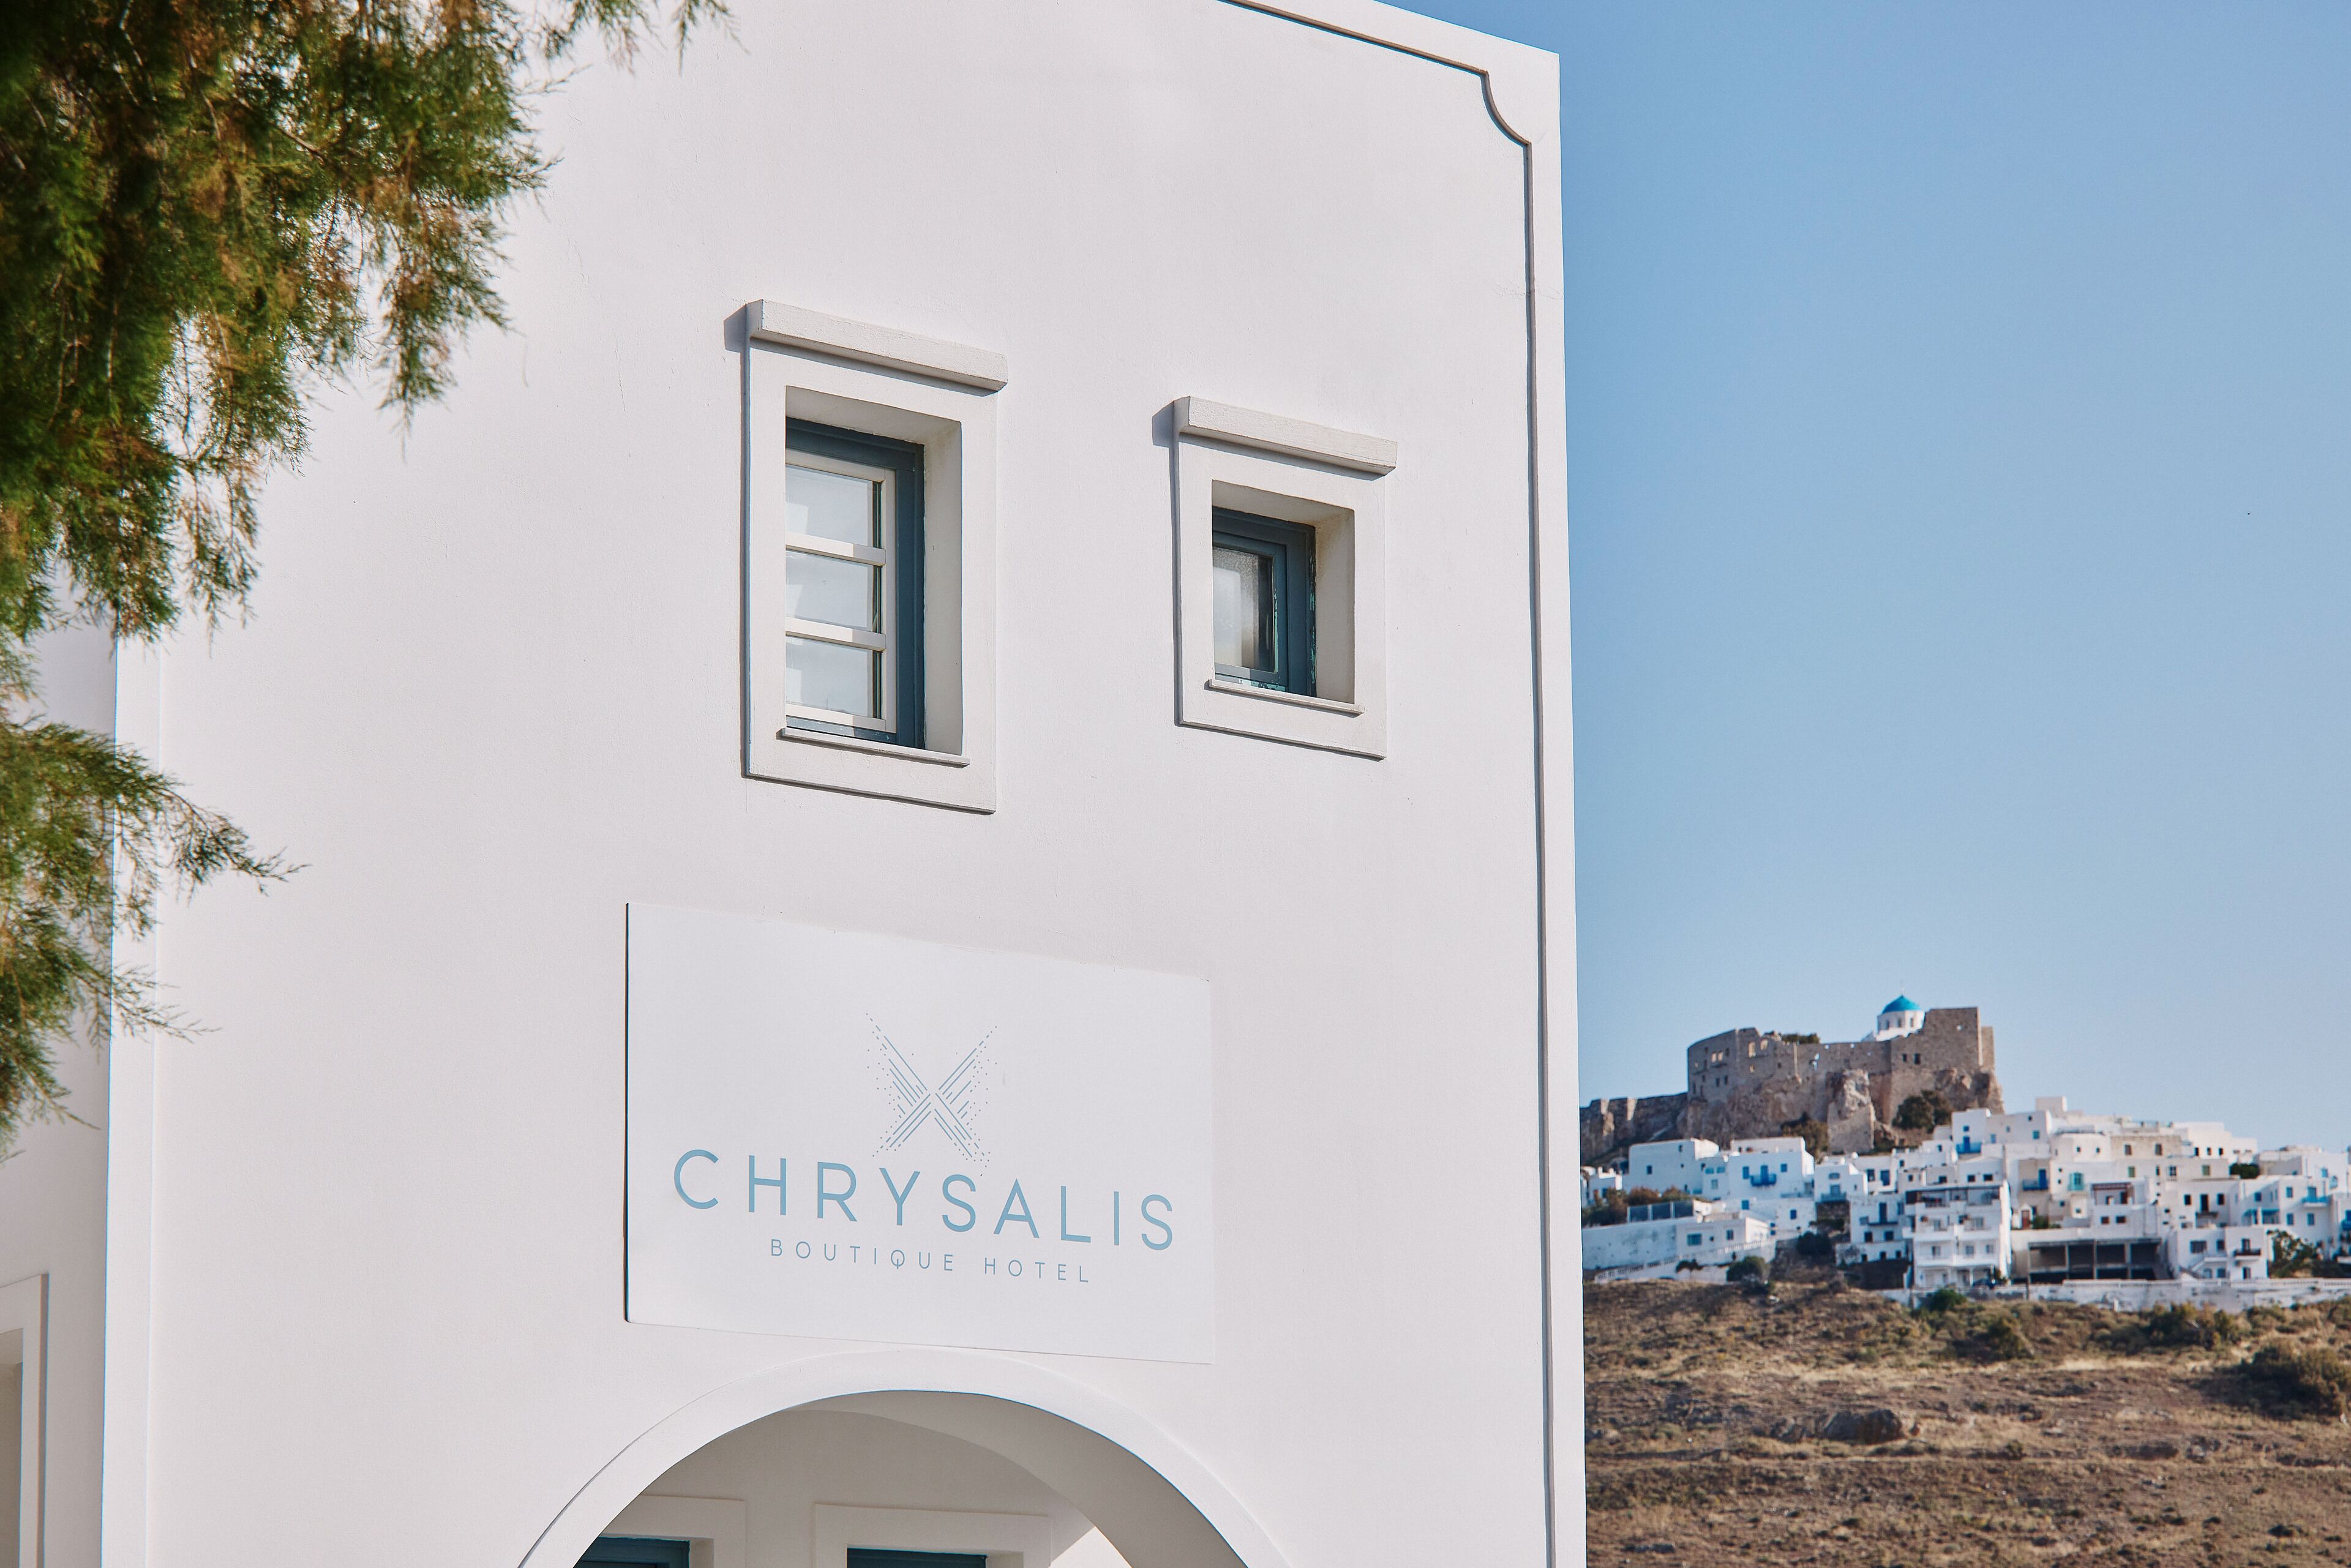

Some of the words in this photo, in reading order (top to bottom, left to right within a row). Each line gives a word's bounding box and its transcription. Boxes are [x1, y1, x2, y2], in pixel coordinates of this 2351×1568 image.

[674, 1149, 1174, 1250] CHRYSALIS
[771, 1239, 954, 1272] BOUTIQUE
[984, 1258, 1089, 1283] HOTEL
